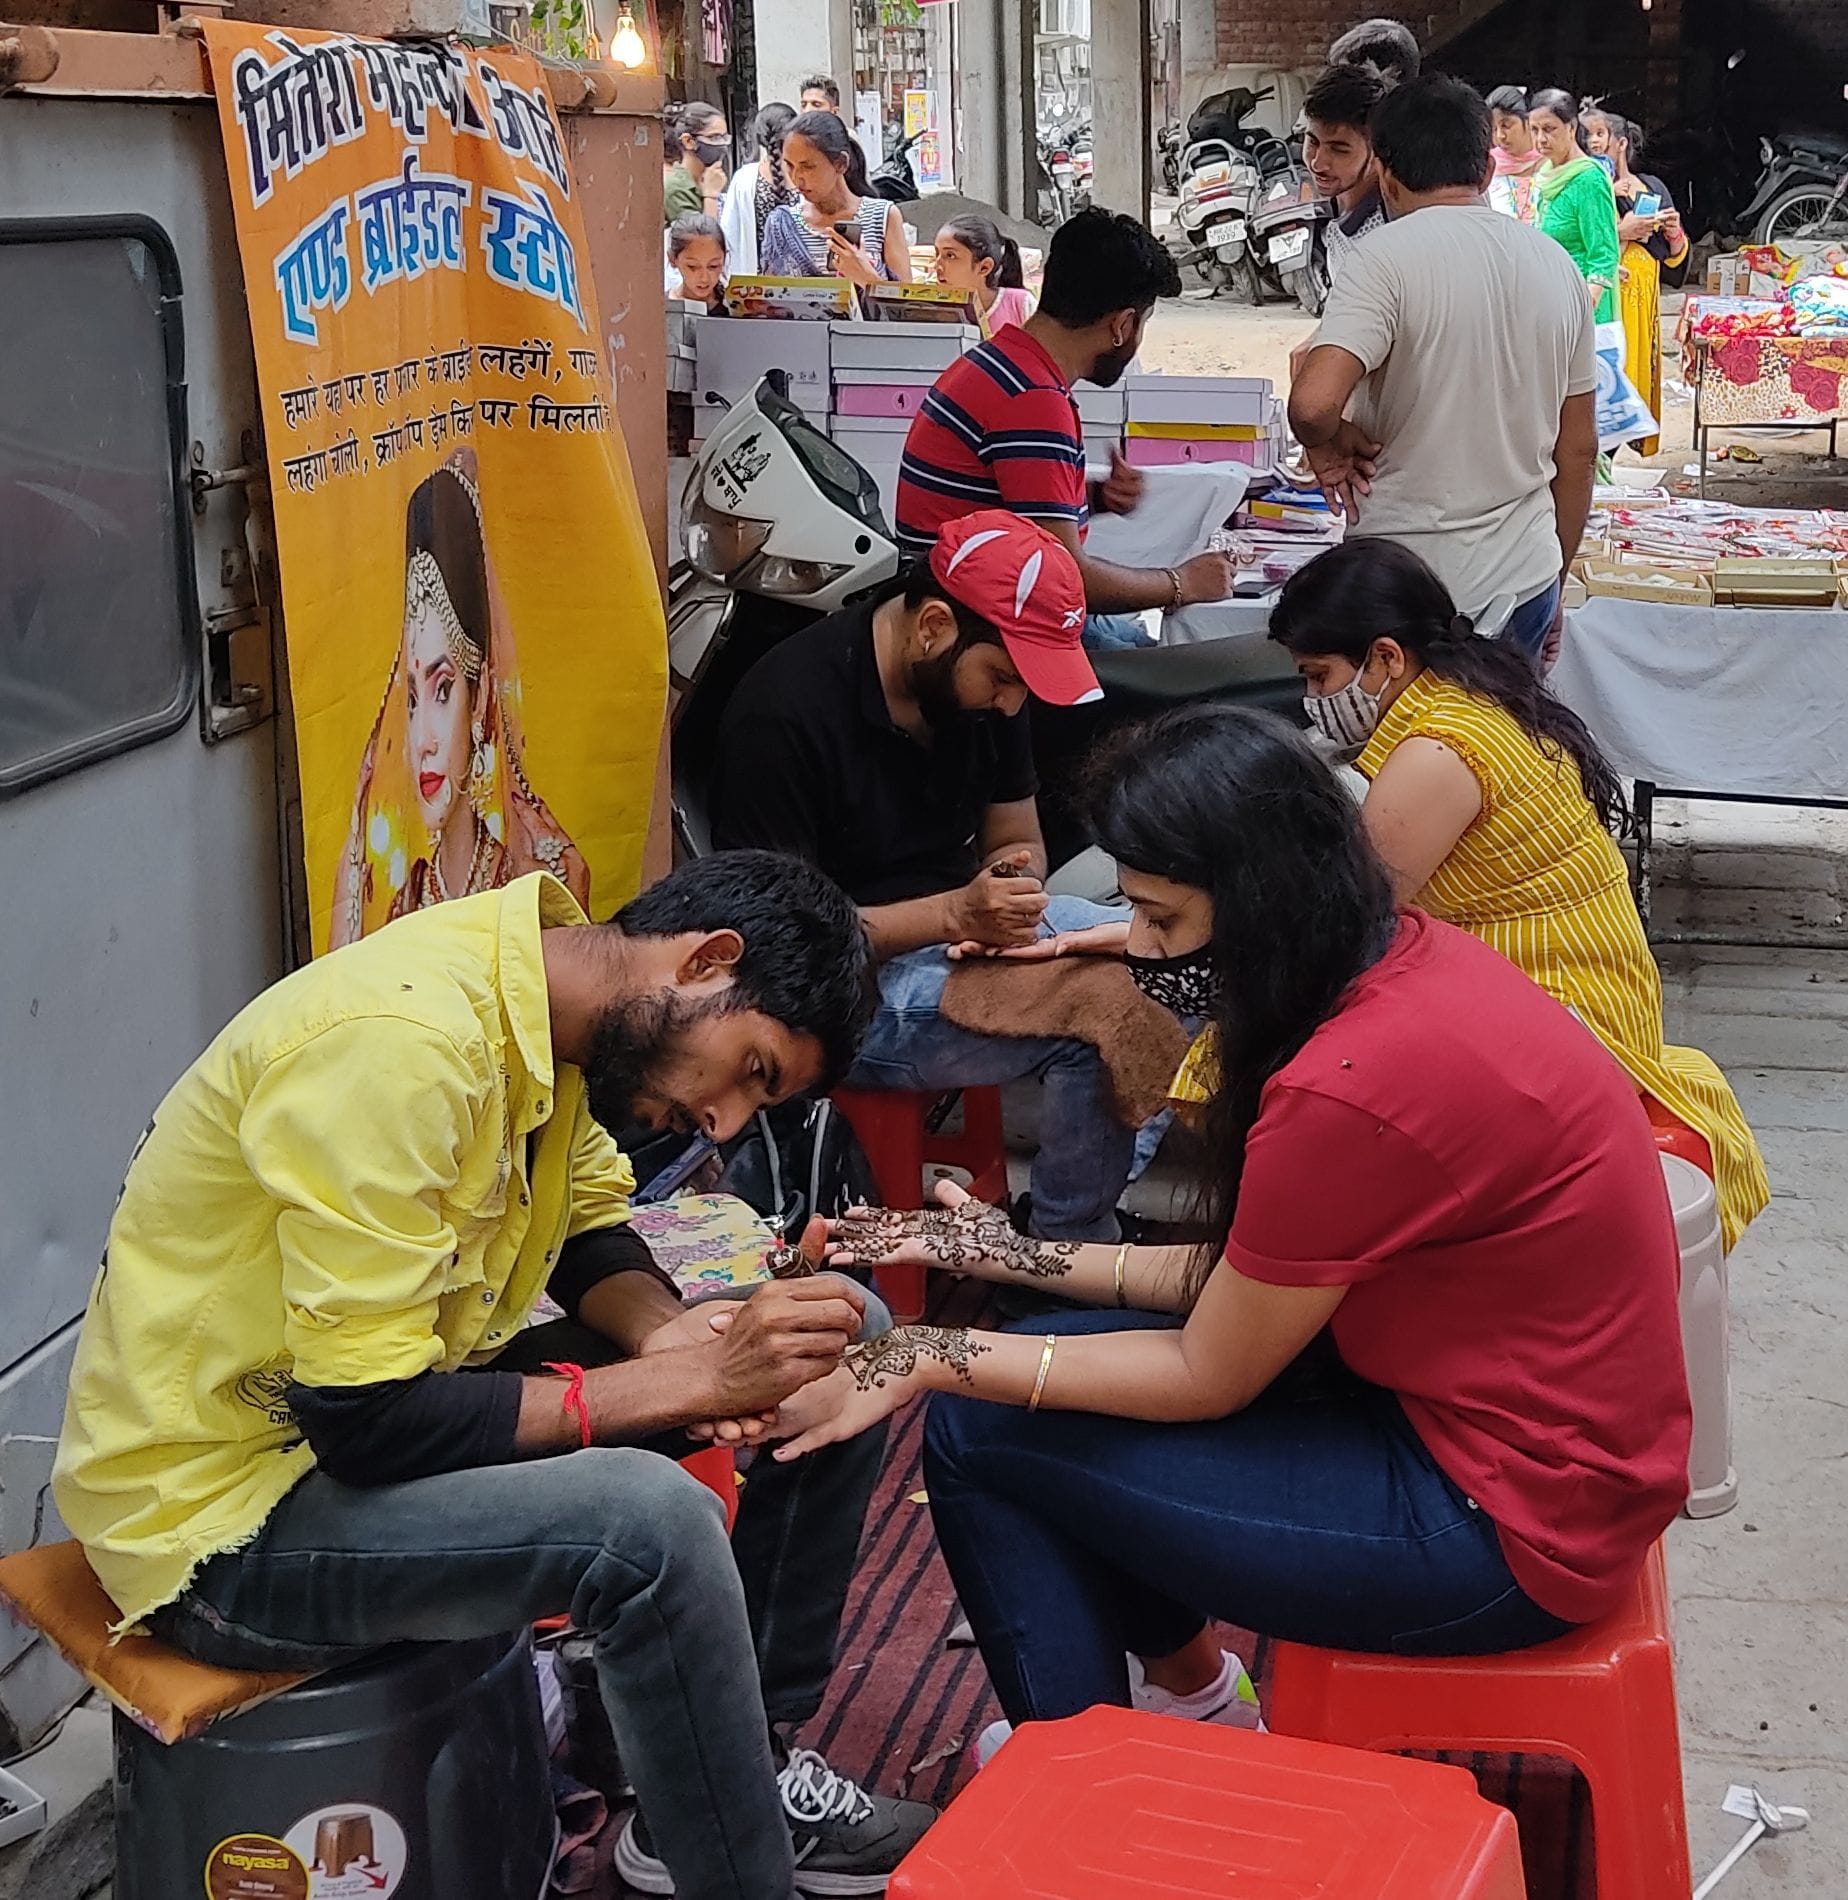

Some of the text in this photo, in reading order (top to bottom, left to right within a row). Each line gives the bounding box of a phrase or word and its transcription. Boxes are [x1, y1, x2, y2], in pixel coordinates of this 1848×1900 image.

[280, 374, 320, 430] हमारे
[343, 374, 367, 407] पर
[370, 370, 391, 406] हर
[282, 443, 328, 493] लहंगा
[478, 399, 520, 429] पर
[526, 393, 605, 432] मिलती
[222, 1852, 291, 1871] nayasa
